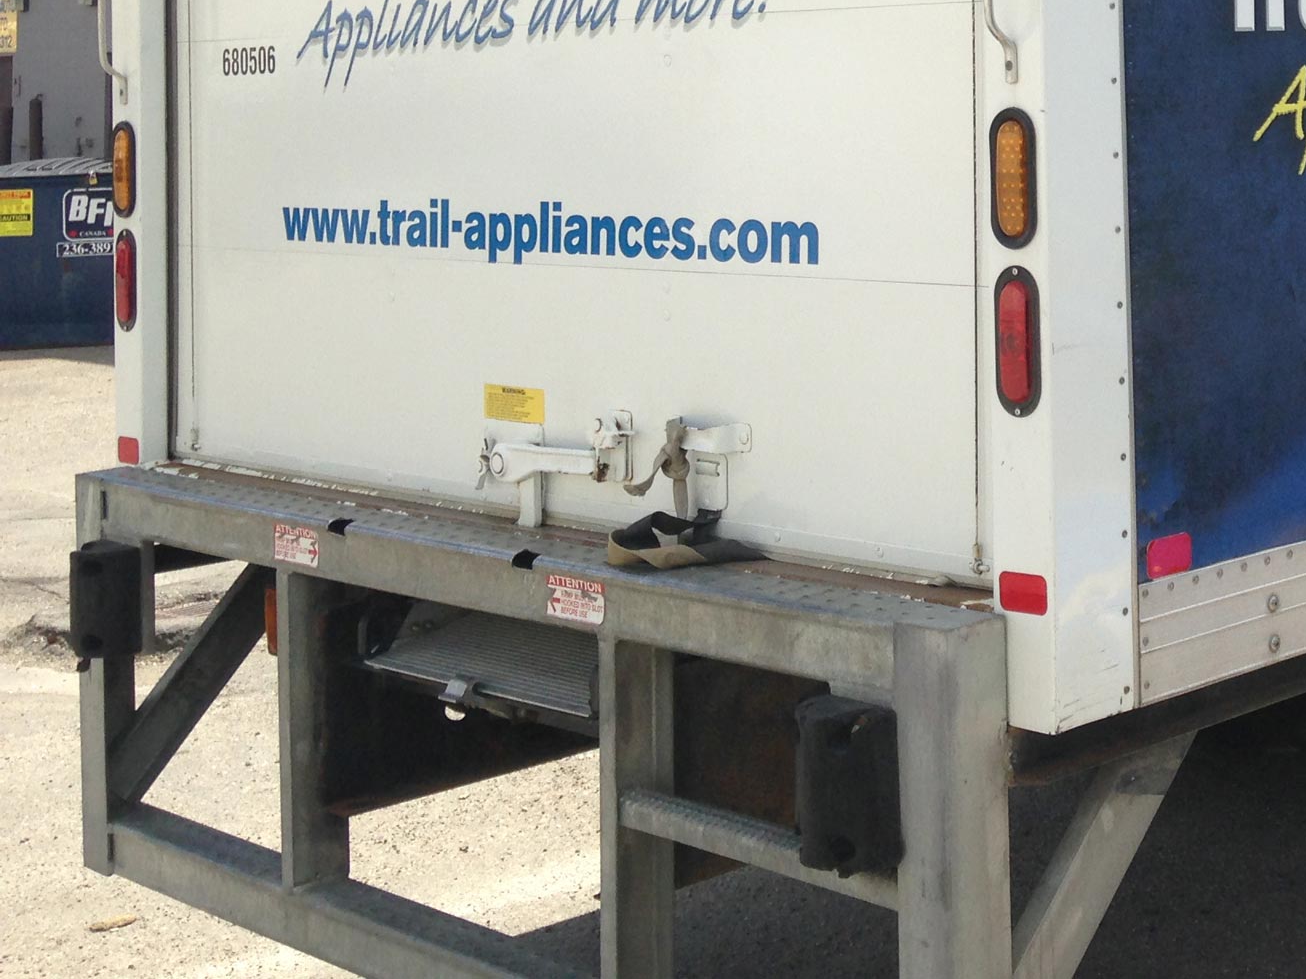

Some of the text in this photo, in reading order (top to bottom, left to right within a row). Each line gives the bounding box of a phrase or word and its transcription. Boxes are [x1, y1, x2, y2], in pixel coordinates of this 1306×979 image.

[222, 45, 276, 76] 680506
[79, 229, 107, 237] CANADA
[282, 198, 820, 265] www.trail-appliances.com
[63, 242, 113, 255] 236-389
[548, 574, 602, 593] ATTENTION
